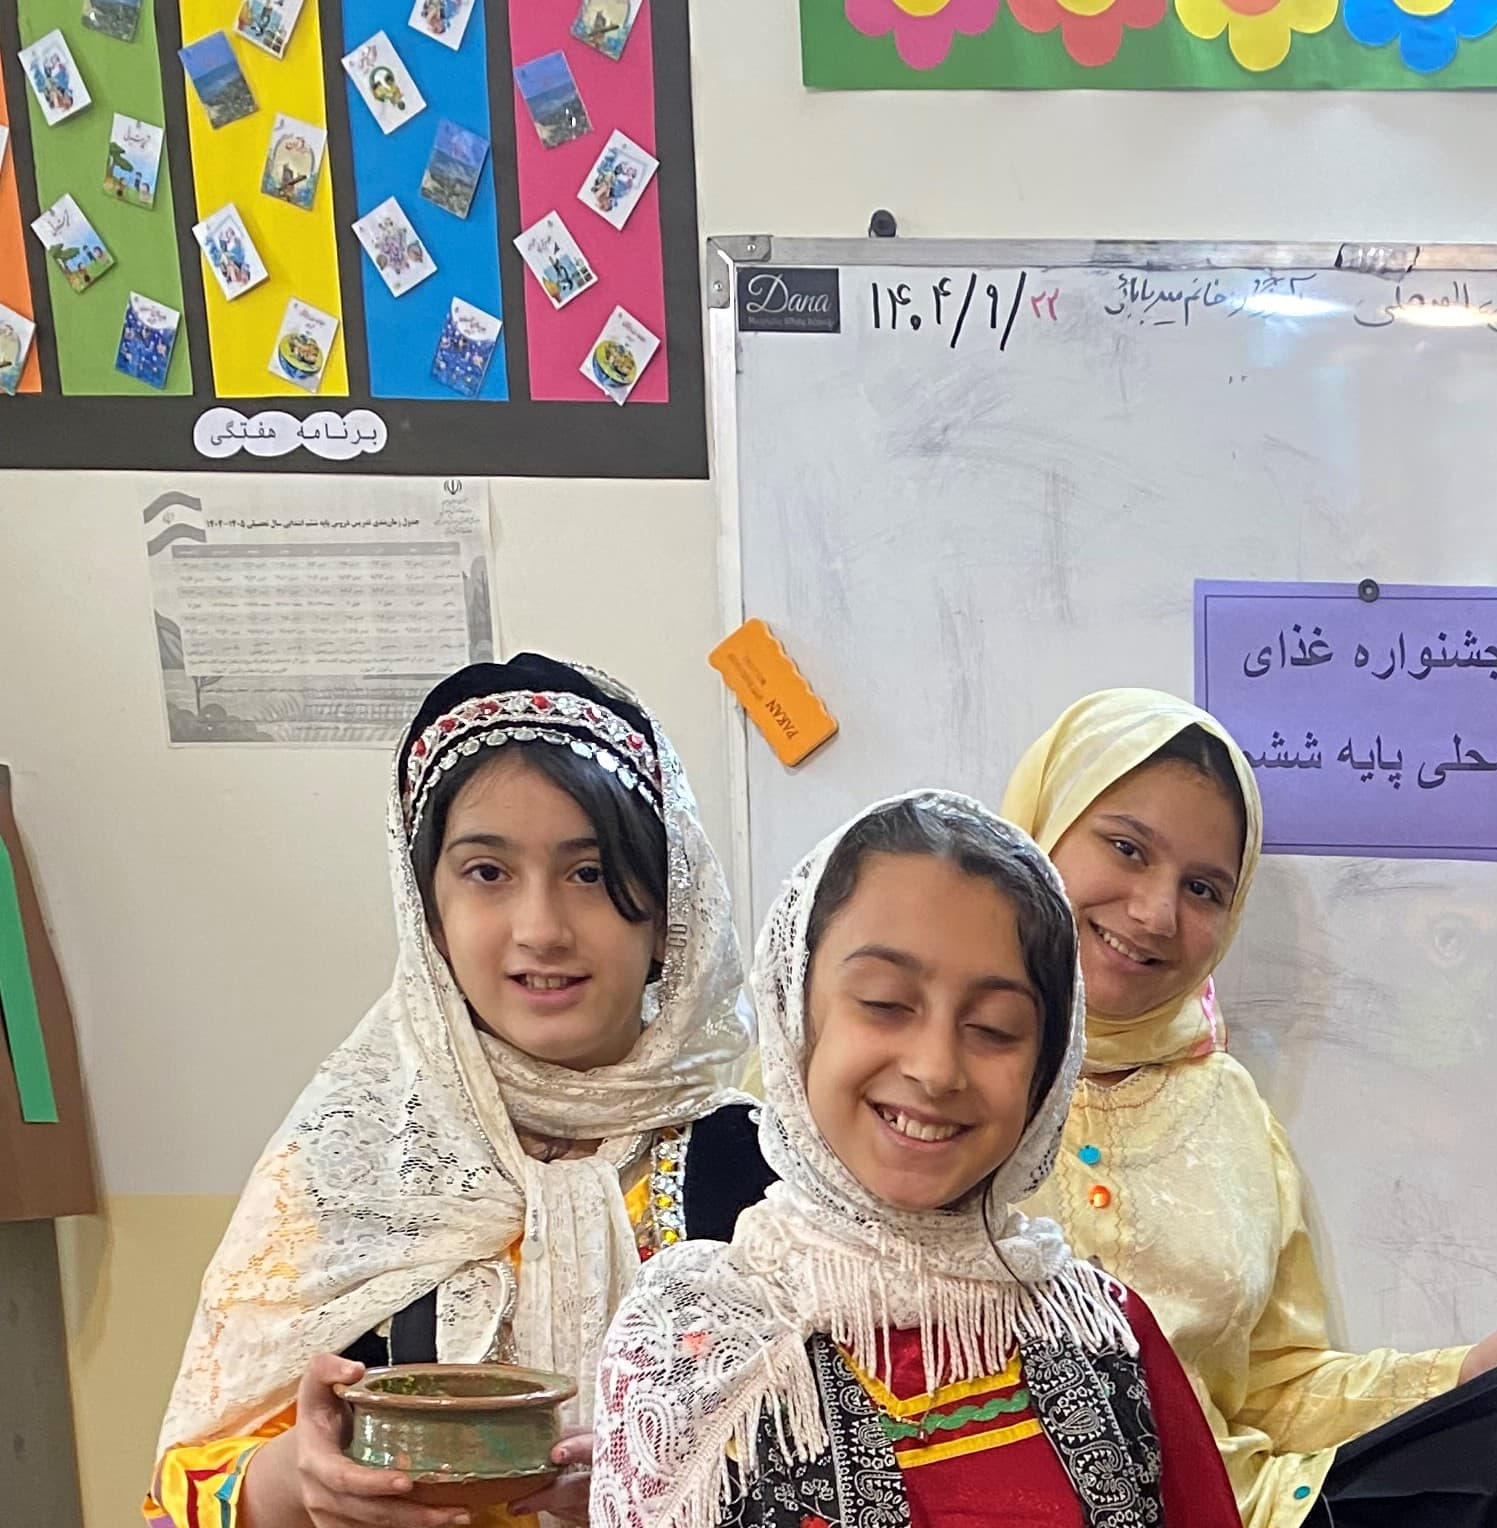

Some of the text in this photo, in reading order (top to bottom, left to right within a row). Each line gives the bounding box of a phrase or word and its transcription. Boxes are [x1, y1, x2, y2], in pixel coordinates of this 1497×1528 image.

[746, 273, 831, 313] Dana
[210, 421, 378, 446] برنامه هفتگی
[1243, 623, 1335, 678] غذای
[764, 698, 800, 740] PAKAN
[1336, 736, 1404, 790] پایه
